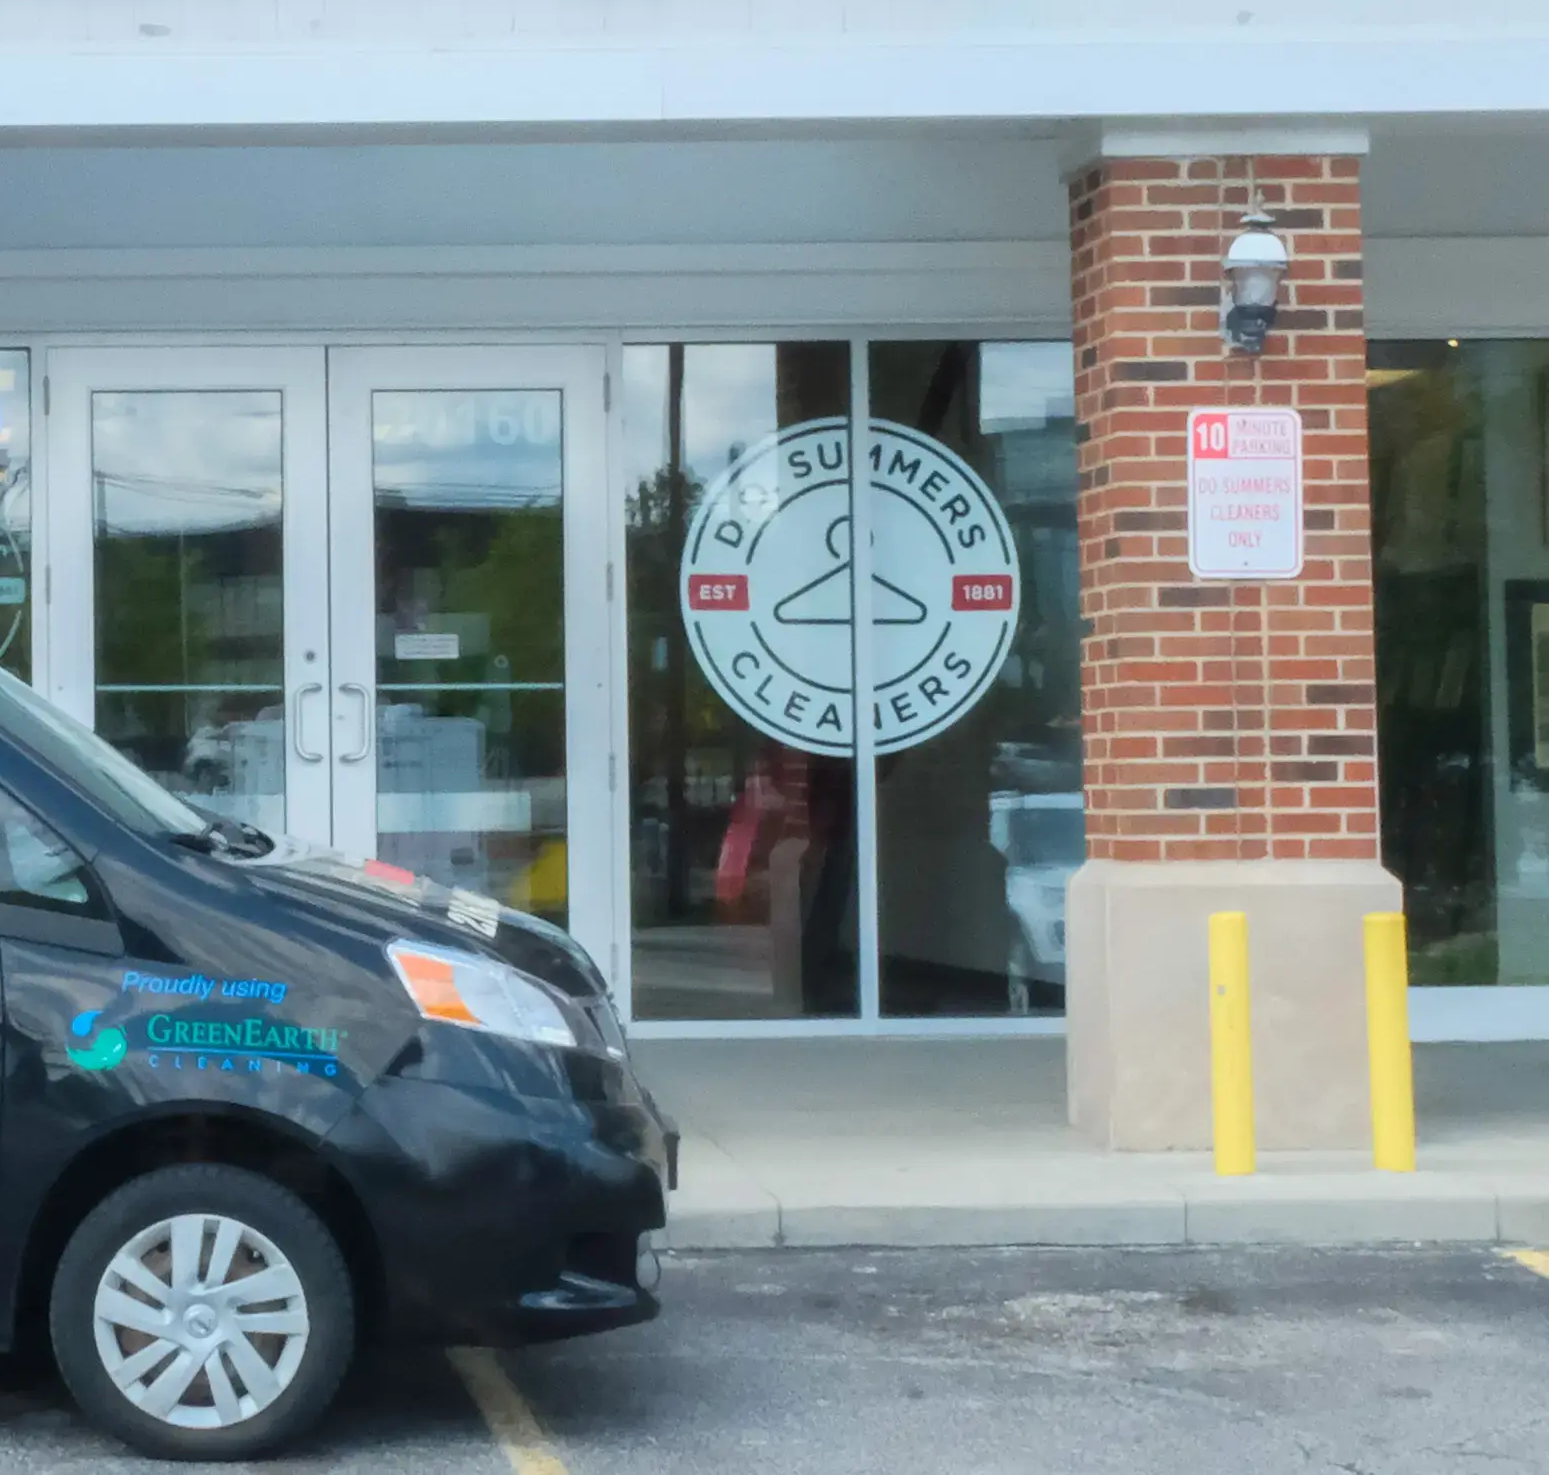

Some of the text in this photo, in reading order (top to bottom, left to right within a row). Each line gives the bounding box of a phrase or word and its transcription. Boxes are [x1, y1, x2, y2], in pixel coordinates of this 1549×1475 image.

[1196, 422, 1225, 451] 10
[1236, 419, 1287, 437] MINUTE
[1233, 439, 1291, 455] PARKING
[1222, 477, 1291, 494] SUMMERS
[1210, 503, 1281, 521] CLEANERS
[1228, 530, 1262, 547] ONLY
[700, 585, 736, 601] EST
[963, 585, 1003, 601] 1881
[122, 971, 288, 1003] Proudly using
[148, 1054, 337, 1076] CLEANING
